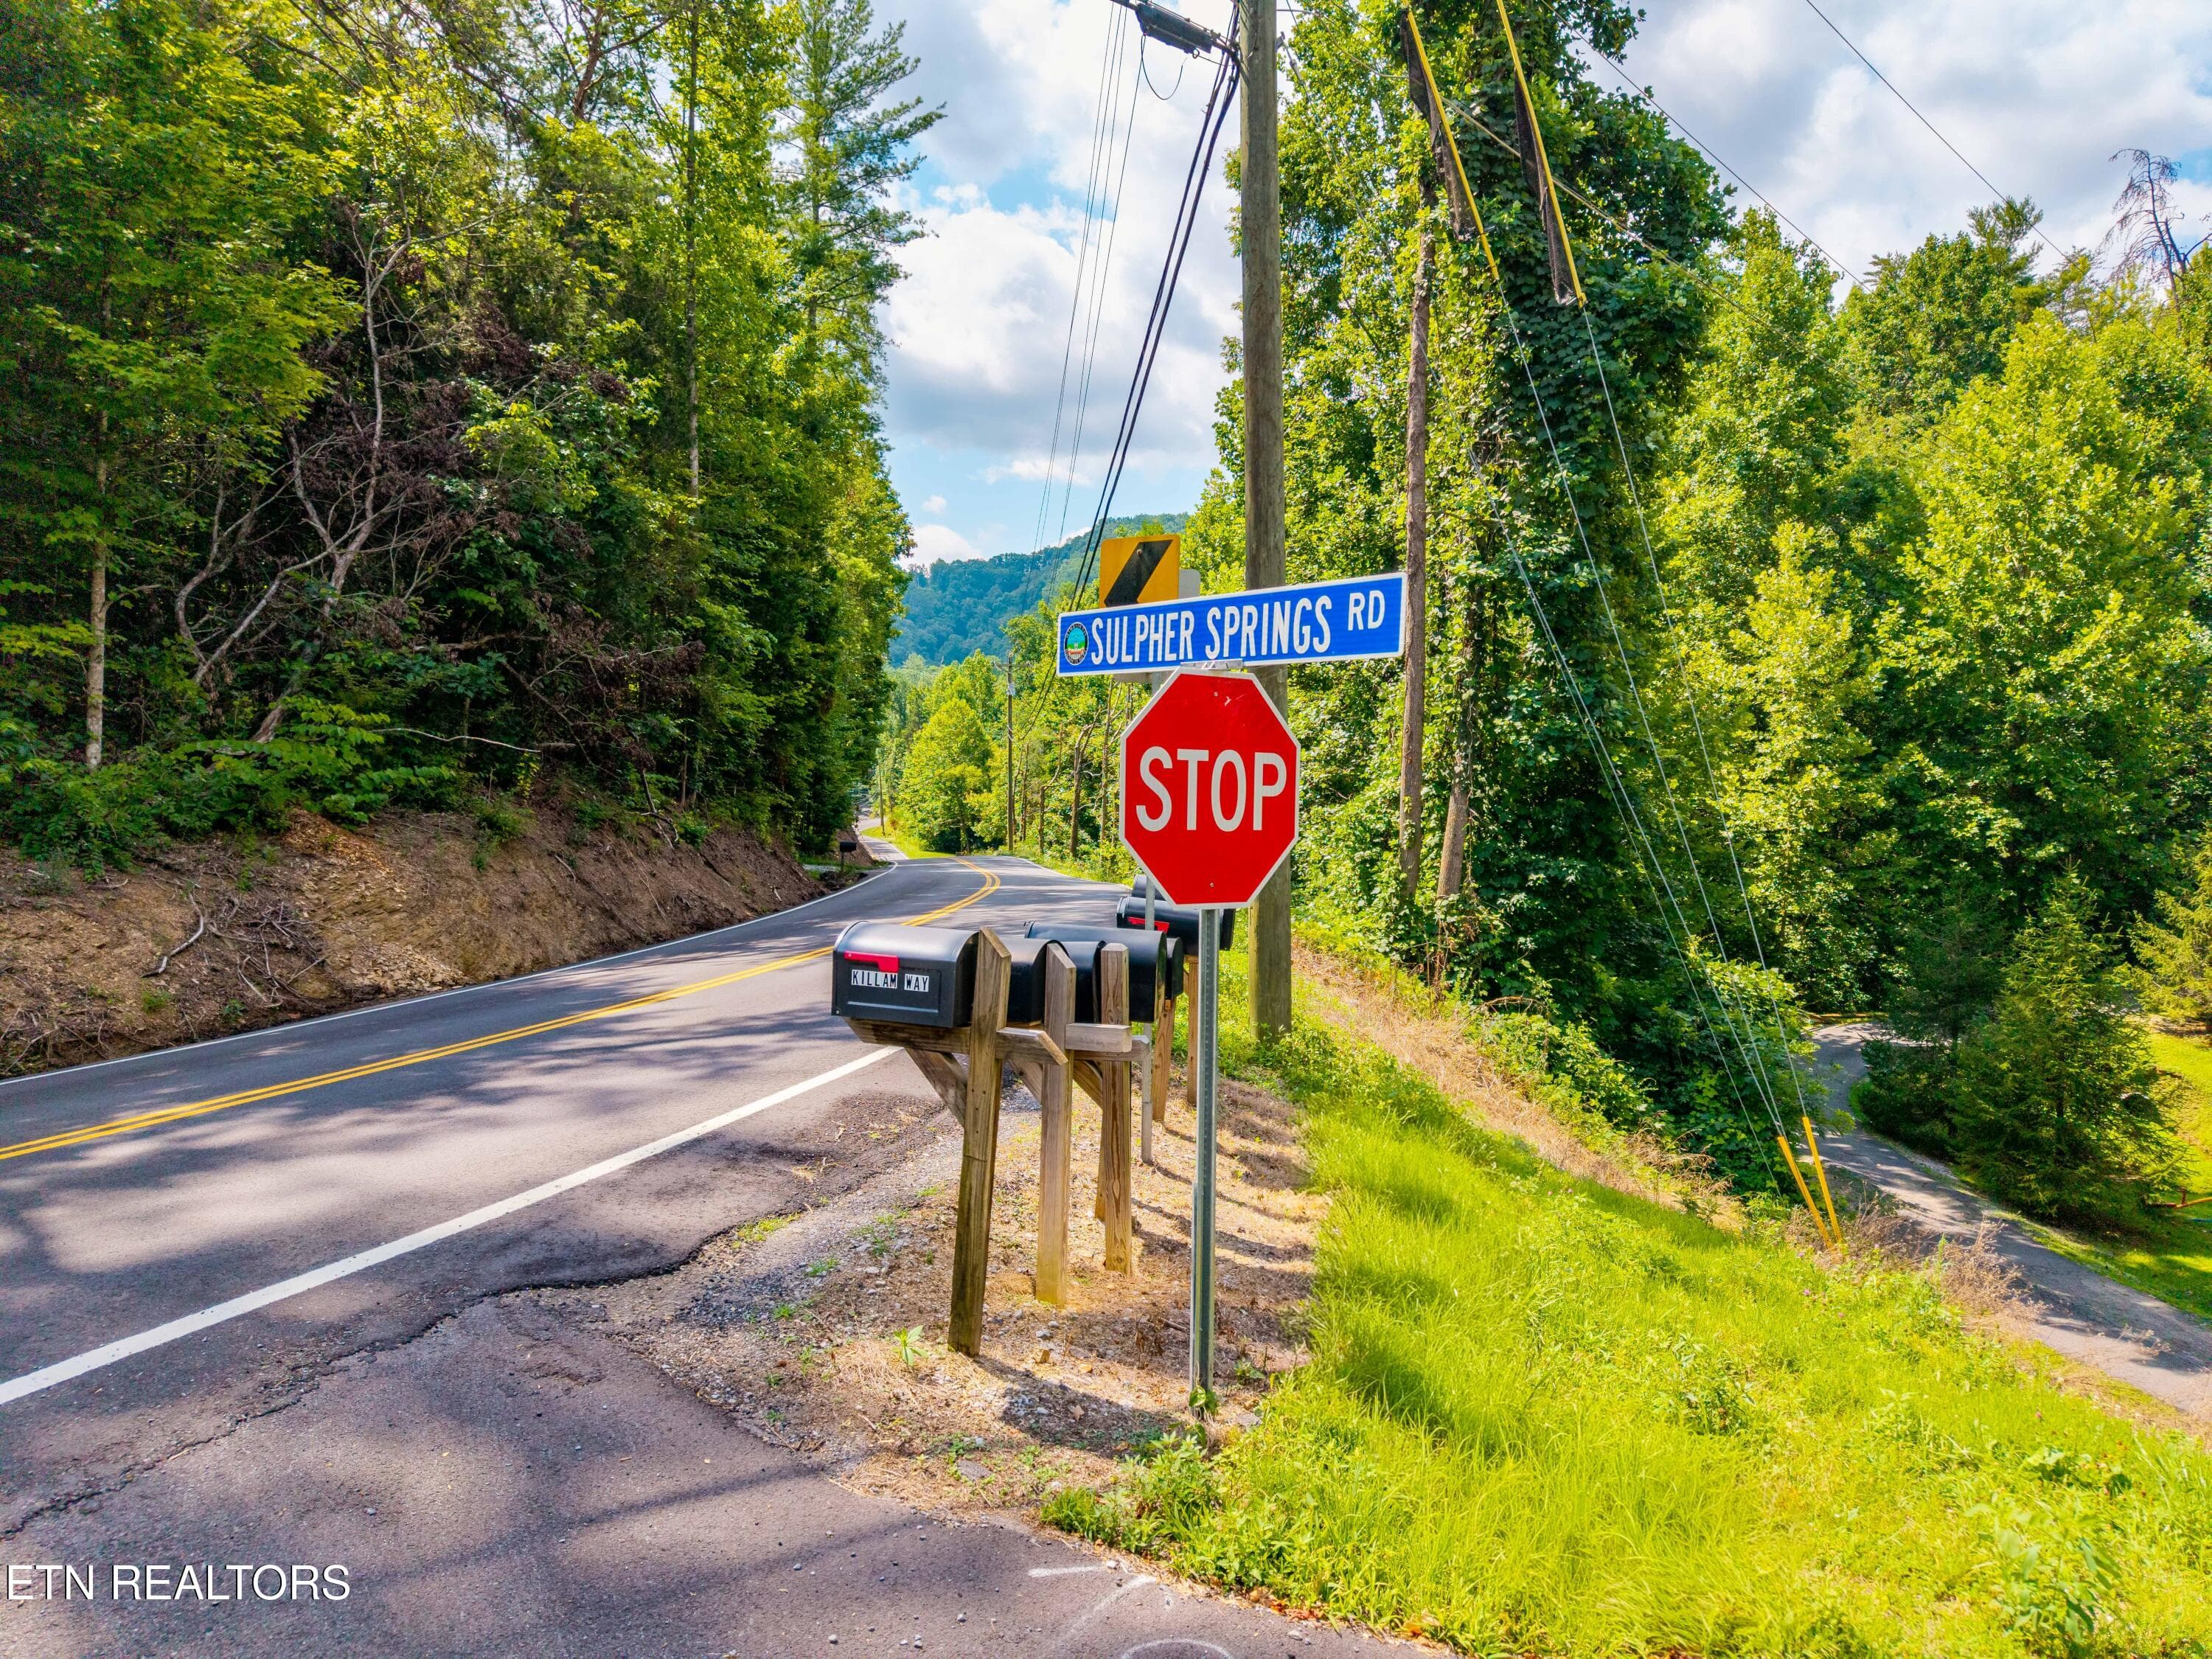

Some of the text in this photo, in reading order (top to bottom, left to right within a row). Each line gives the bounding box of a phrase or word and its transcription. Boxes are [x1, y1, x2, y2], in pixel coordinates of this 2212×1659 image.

[1091, 590, 1385, 664] SULPHER SPRINGS RD
[1136, 746, 1287, 832] STOP
[853, 970, 928, 991] KILLAM WAY
